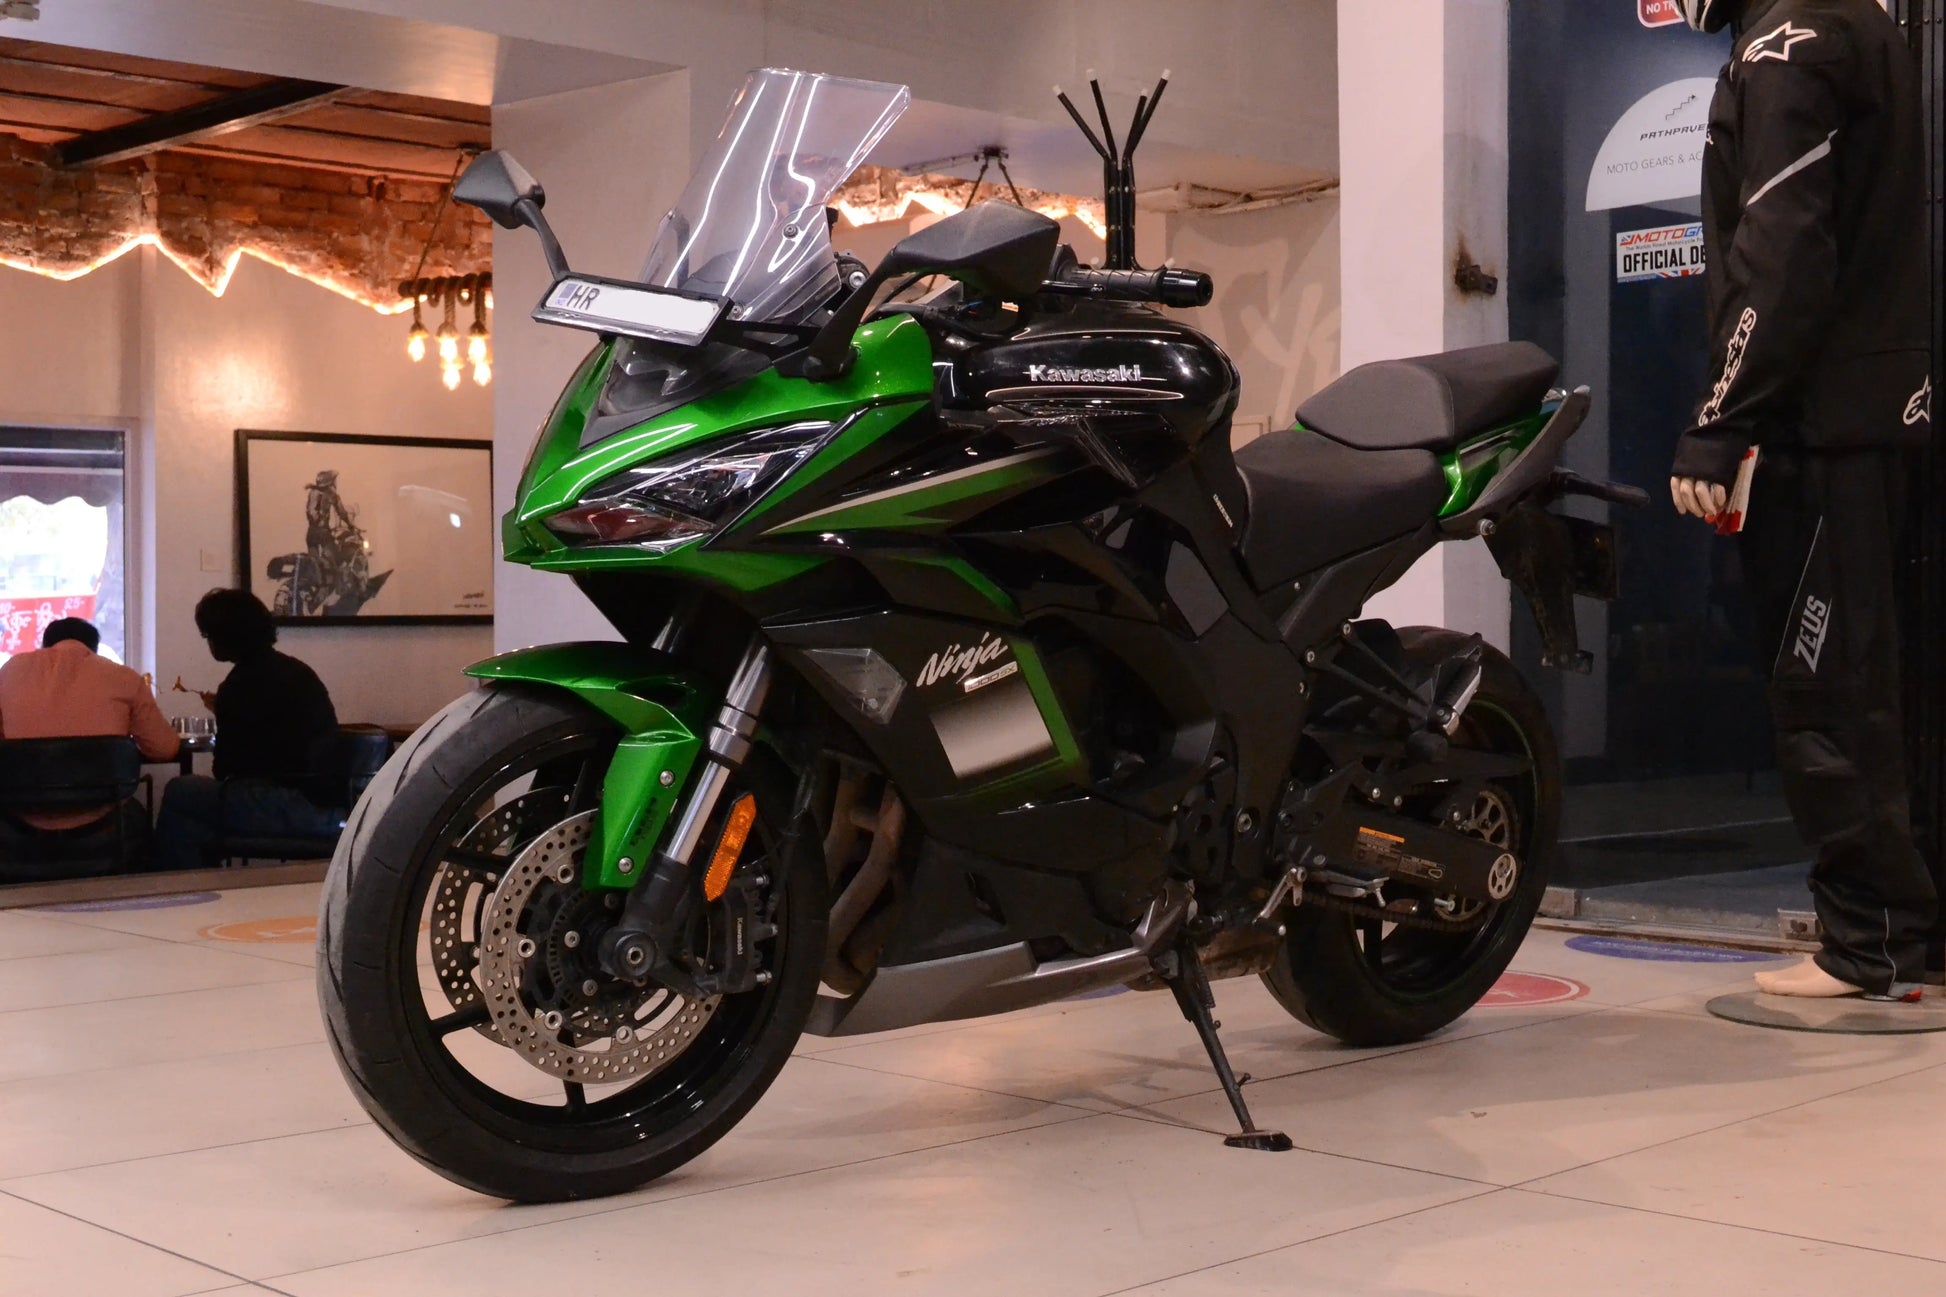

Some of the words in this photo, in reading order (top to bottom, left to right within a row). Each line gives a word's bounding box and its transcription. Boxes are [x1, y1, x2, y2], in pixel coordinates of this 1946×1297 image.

[1646, 2, 1661, 15] NO
[1607, 160, 1639, 175] MOTO
[1641, 154, 1675, 169] GEARS
[1678, 153, 1685, 163] &
[1623, 247, 1686, 273] OFFICIAL
[567, 285, 600, 310] HR
[1028, 364, 1141, 382] Kawasaki
[1793, 594, 1828, 674] ZEUS
[916, 631, 1008, 687] Ninja
